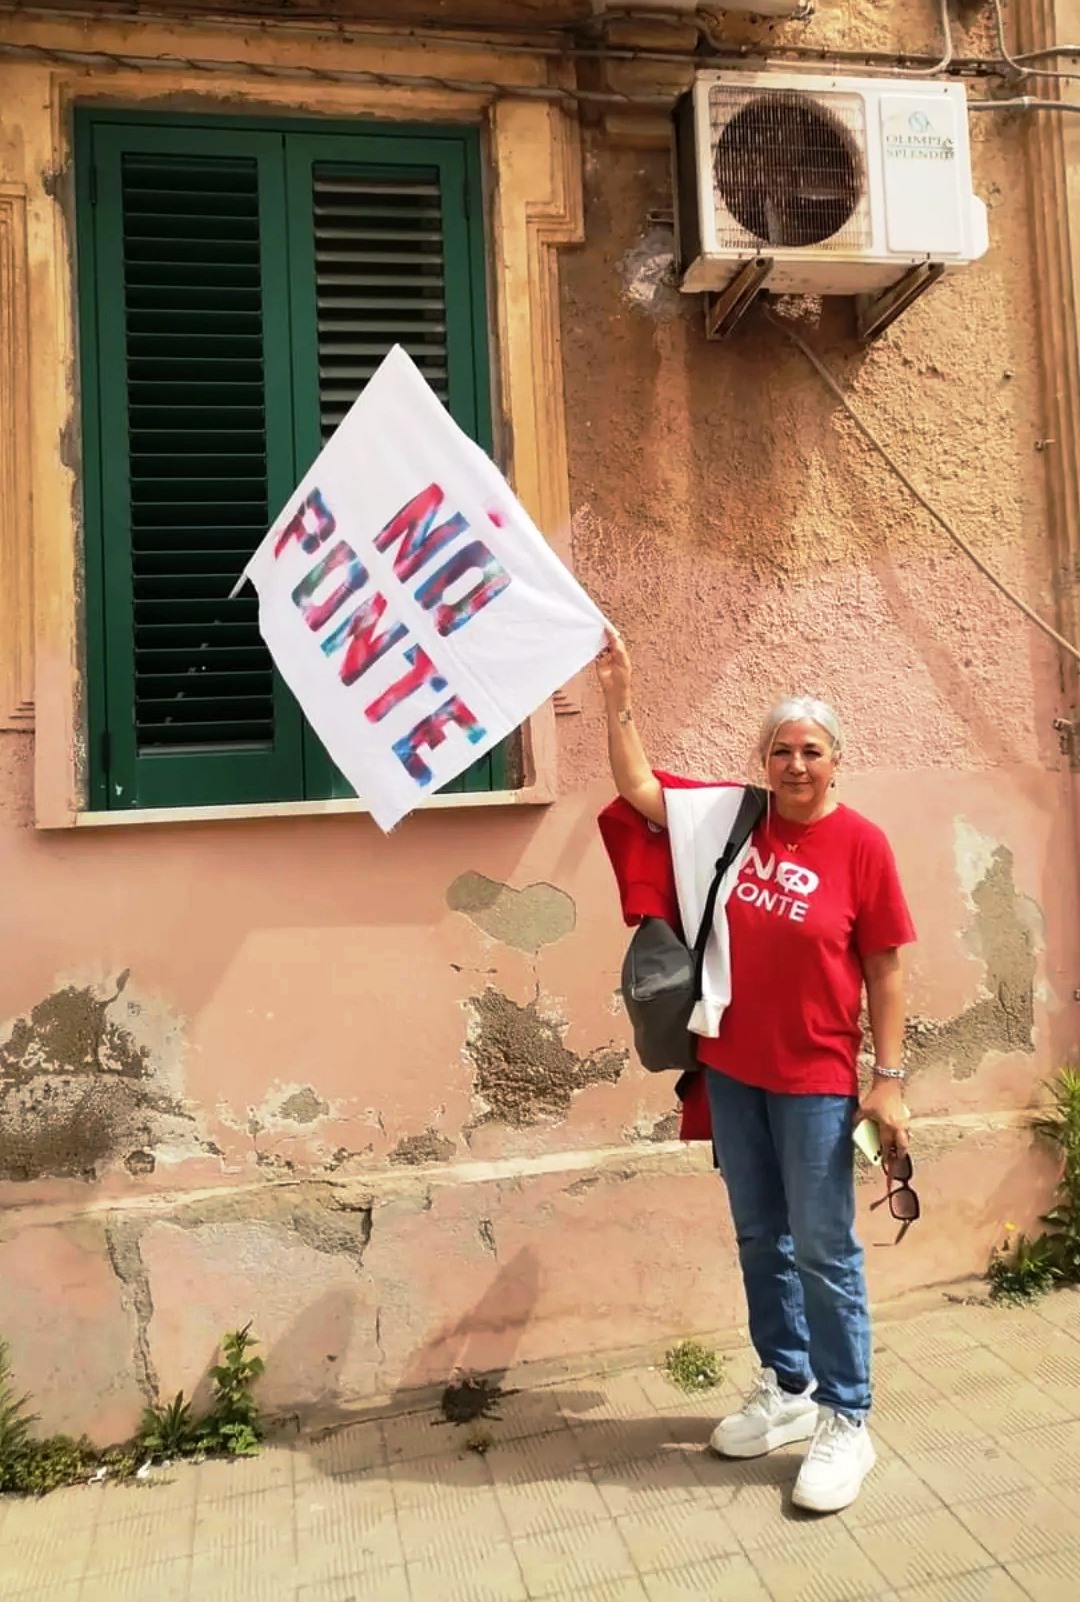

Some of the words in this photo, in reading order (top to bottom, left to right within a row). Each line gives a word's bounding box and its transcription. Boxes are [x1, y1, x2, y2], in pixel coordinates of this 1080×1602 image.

[372, 482, 513, 638] NO
[274, 486, 487, 788] PONTE
[735, 882, 810, 922] ONTE
[739, 845, 820, 897] NO
